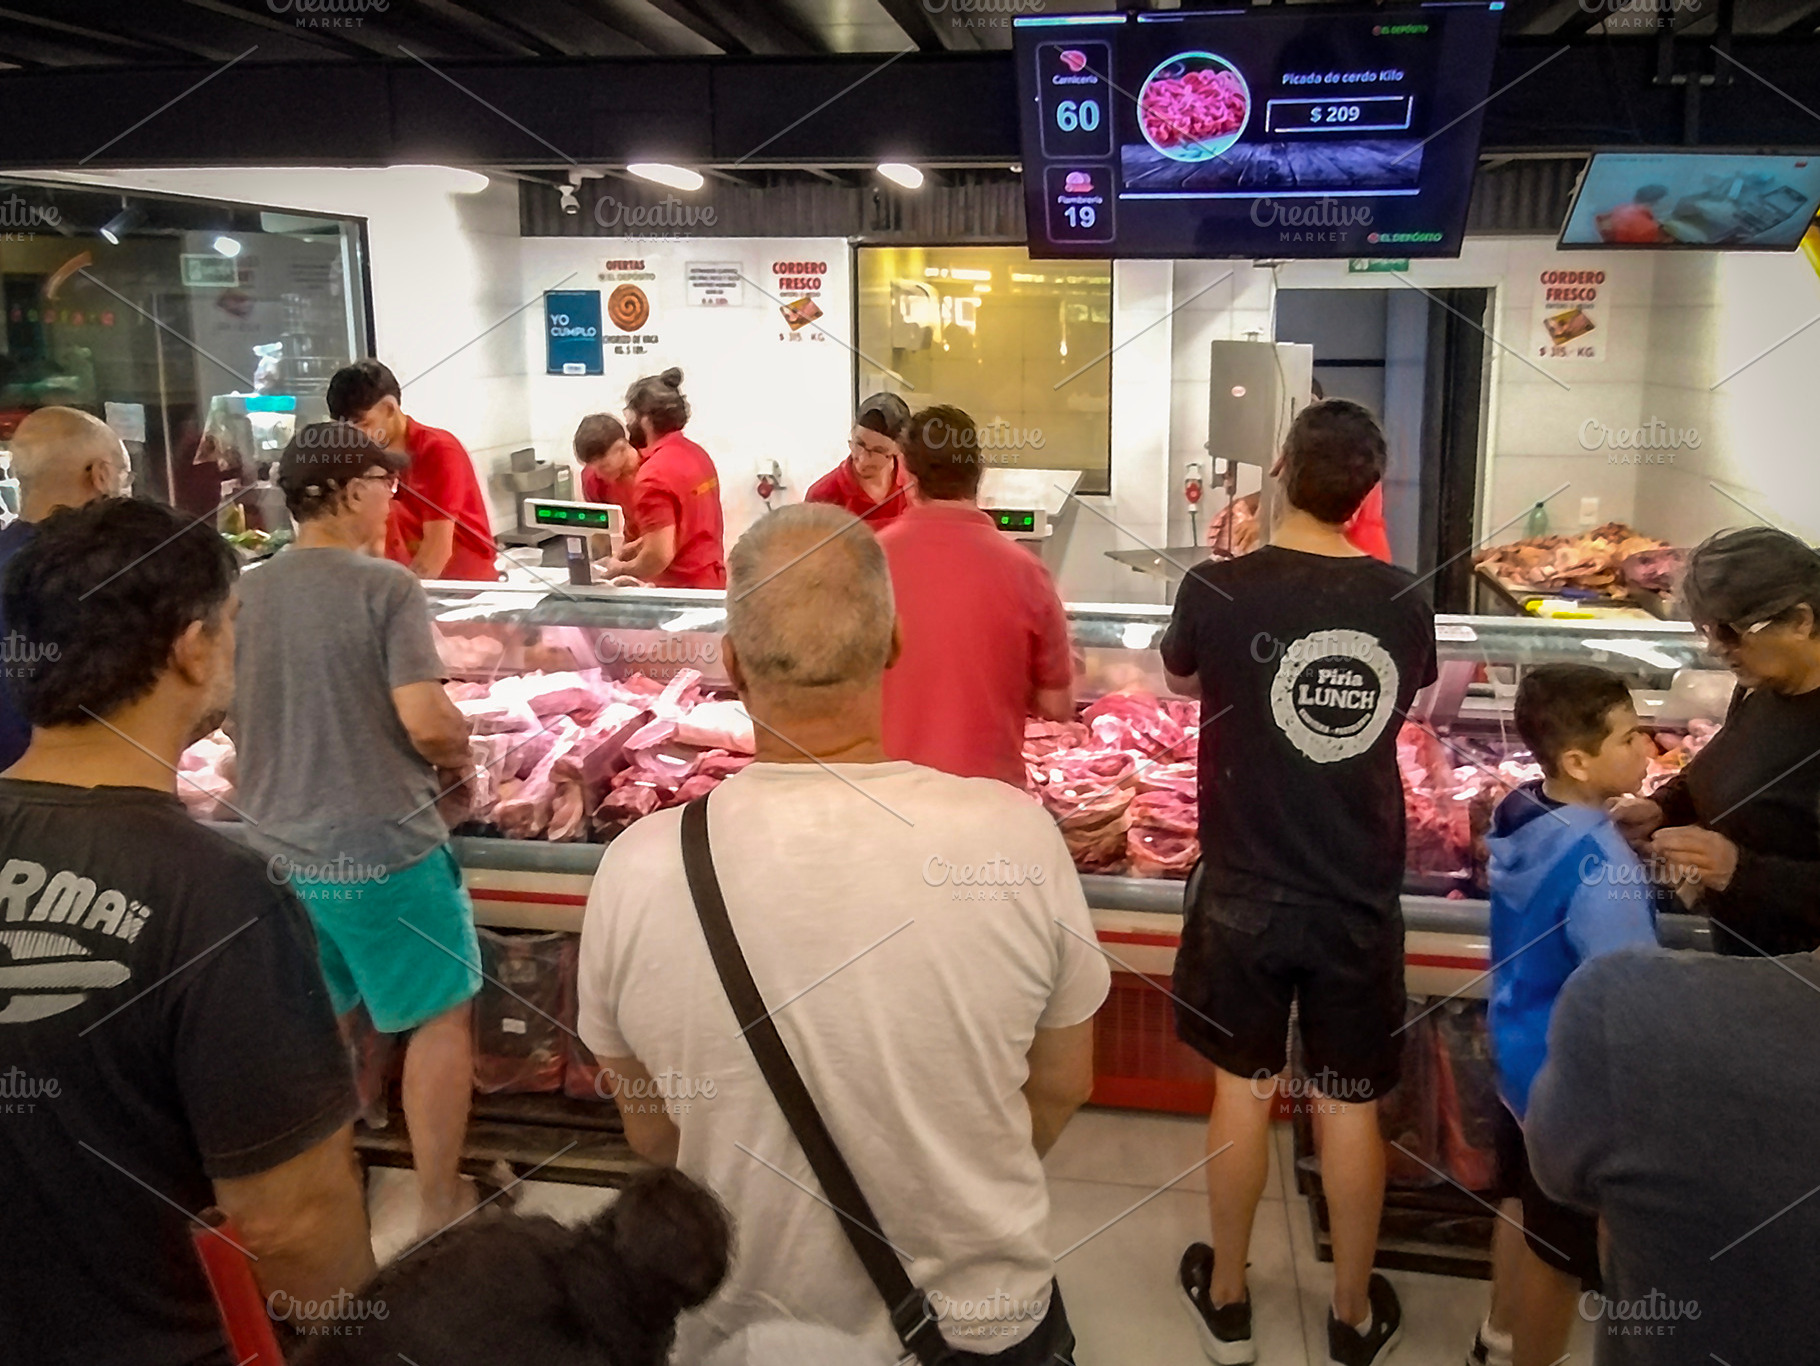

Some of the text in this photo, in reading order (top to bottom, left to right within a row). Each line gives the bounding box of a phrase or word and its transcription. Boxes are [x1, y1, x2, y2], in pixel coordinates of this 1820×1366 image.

[1282, 69, 1405, 85] Picada de cerdo Kilo
[1056, 100, 1100, 132] 60
[1310, 106, 1360, 123] $ 209
[1064, 206, 1096, 228] 19
[606, 260, 645, 271] OFERTAS
[772, 261, 828, 274] CORDERO
[779, 277, 822, 290] FRESCO
[1540, 270, 1606, 285] CORDERO
[1546, 287, 1597, 301] FRESCO
[550, 314, 570, 326] YO
[551, 327, 597, 337] CUMPLO
[1539, 347, 1546, 357] $
[1577, 347, 1596, 357] KG
[1297, 684, 1376, 709] LUNCH
